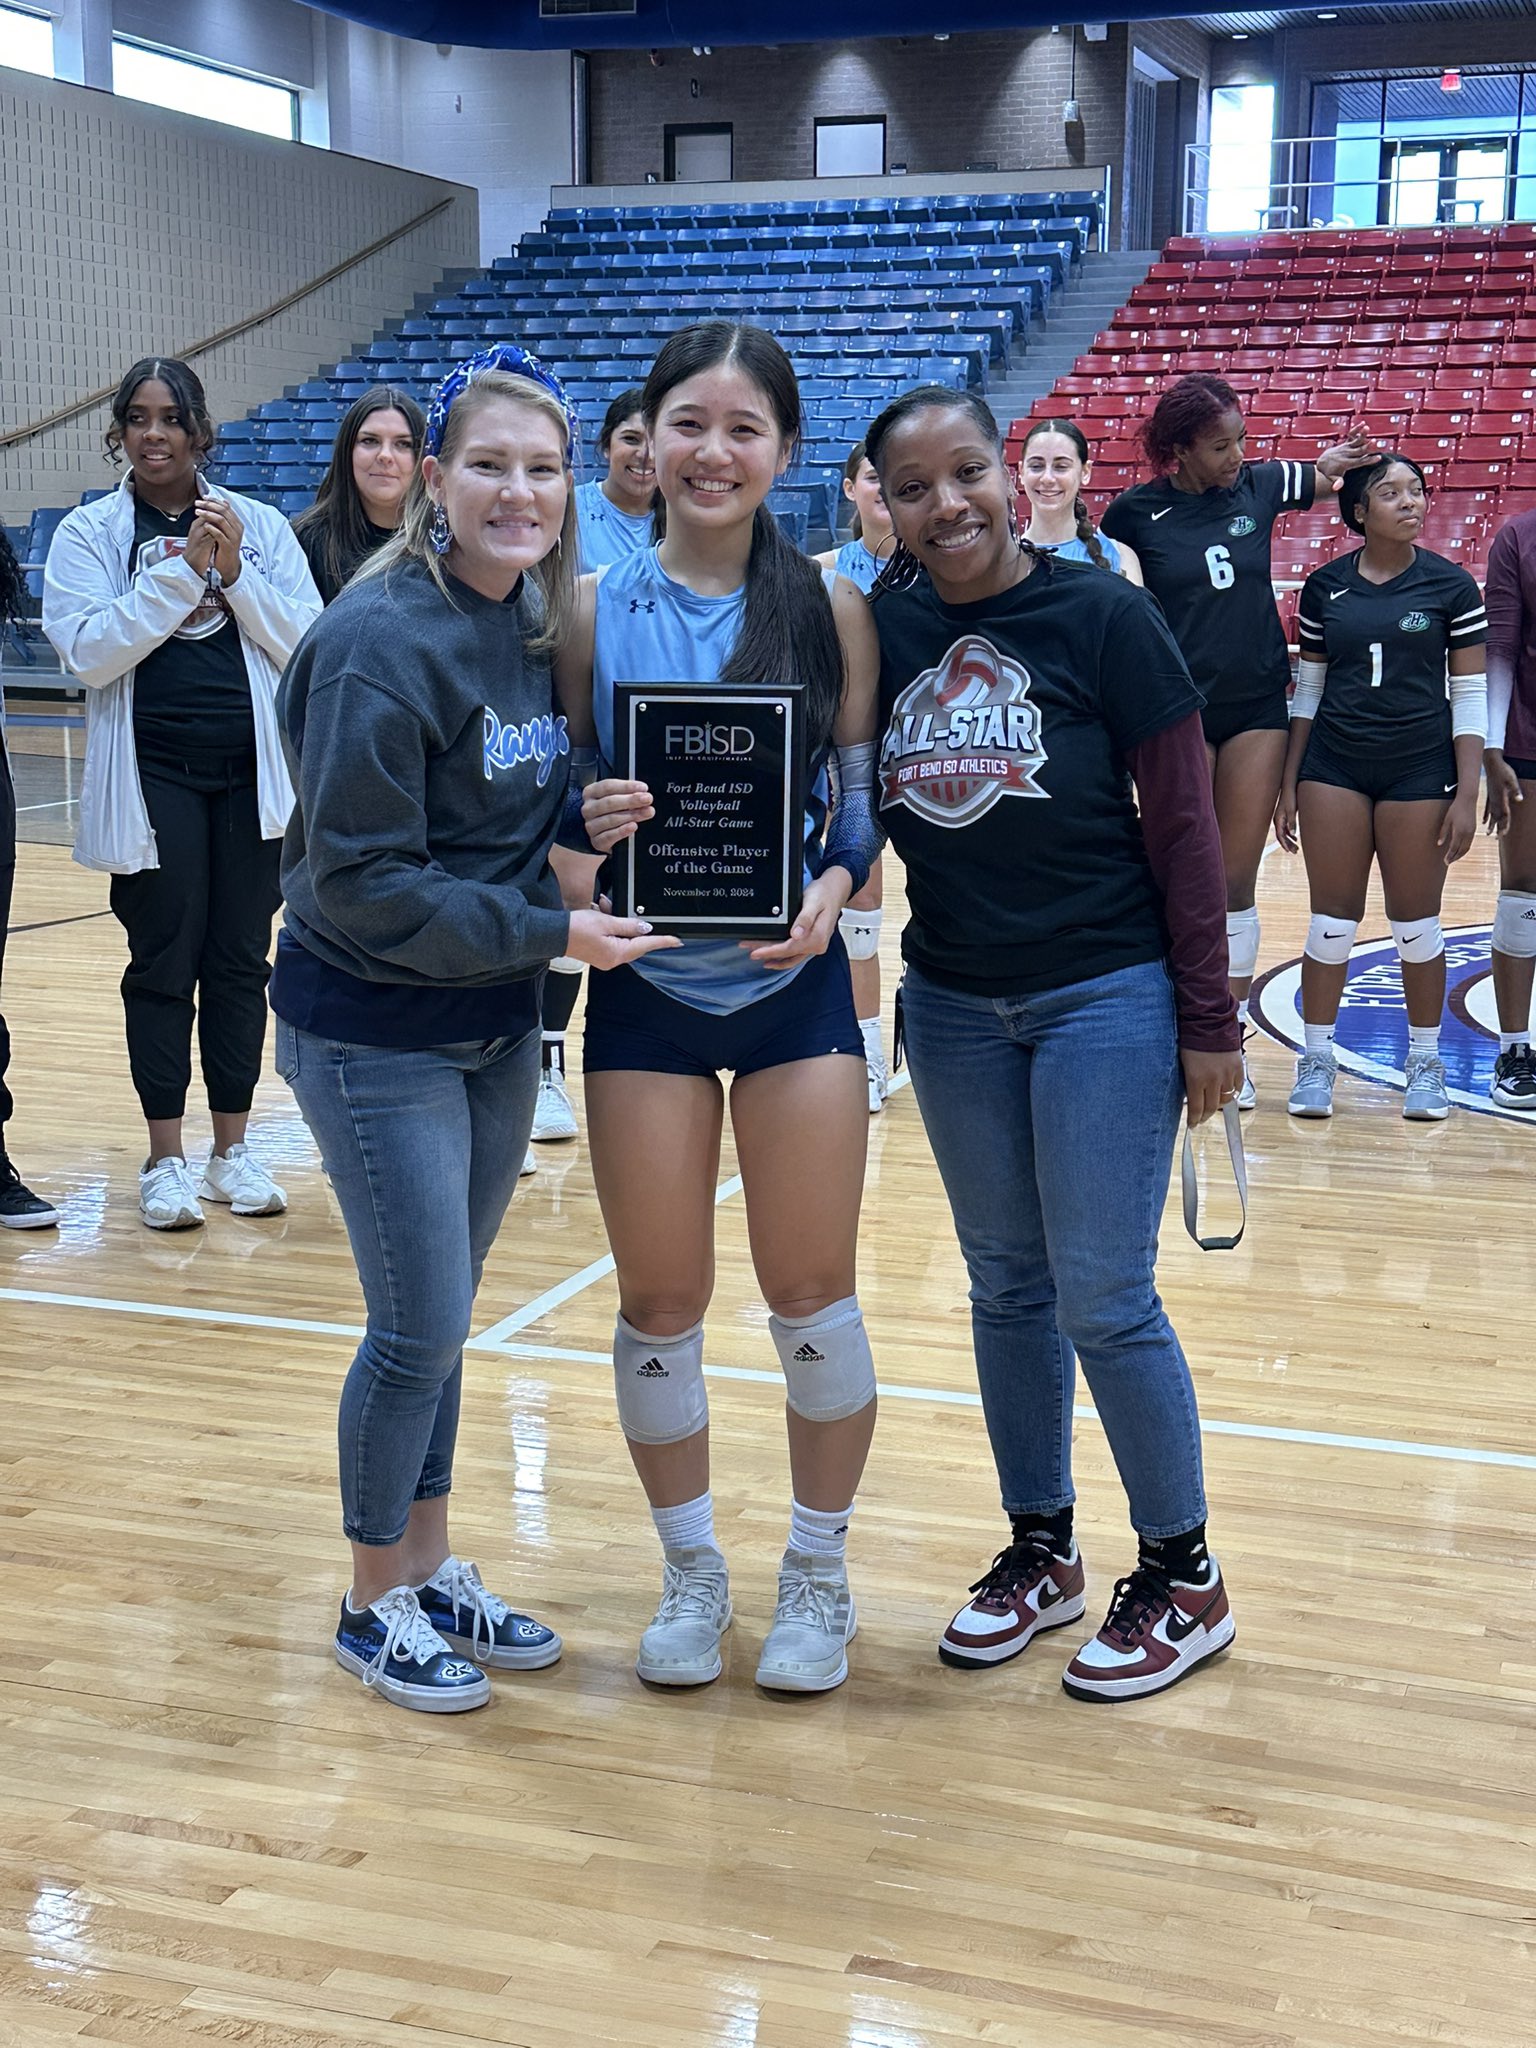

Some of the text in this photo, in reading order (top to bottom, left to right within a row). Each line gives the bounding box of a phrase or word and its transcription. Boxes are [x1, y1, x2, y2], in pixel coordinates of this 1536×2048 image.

[1204, 545, 1235, 590] 6
[1369, 643, 1383, 687] 1
[882, 704, 1035, 764] ALL-STAR
[897, 759, 1008, 783] FORT BEND ISD ATHLETICS
[666, 782, 753, 794] Fort Bend ISD
[680, 800, 741, 814] Volleyball
[664, 816, 754, 828] All-Star Game
[648, 844, 770, 860] Offensive Player
[664, 861, 754, 874] of the Game
[663, 887, 711, 897] November
[730, 887, 754, 897] 2024
